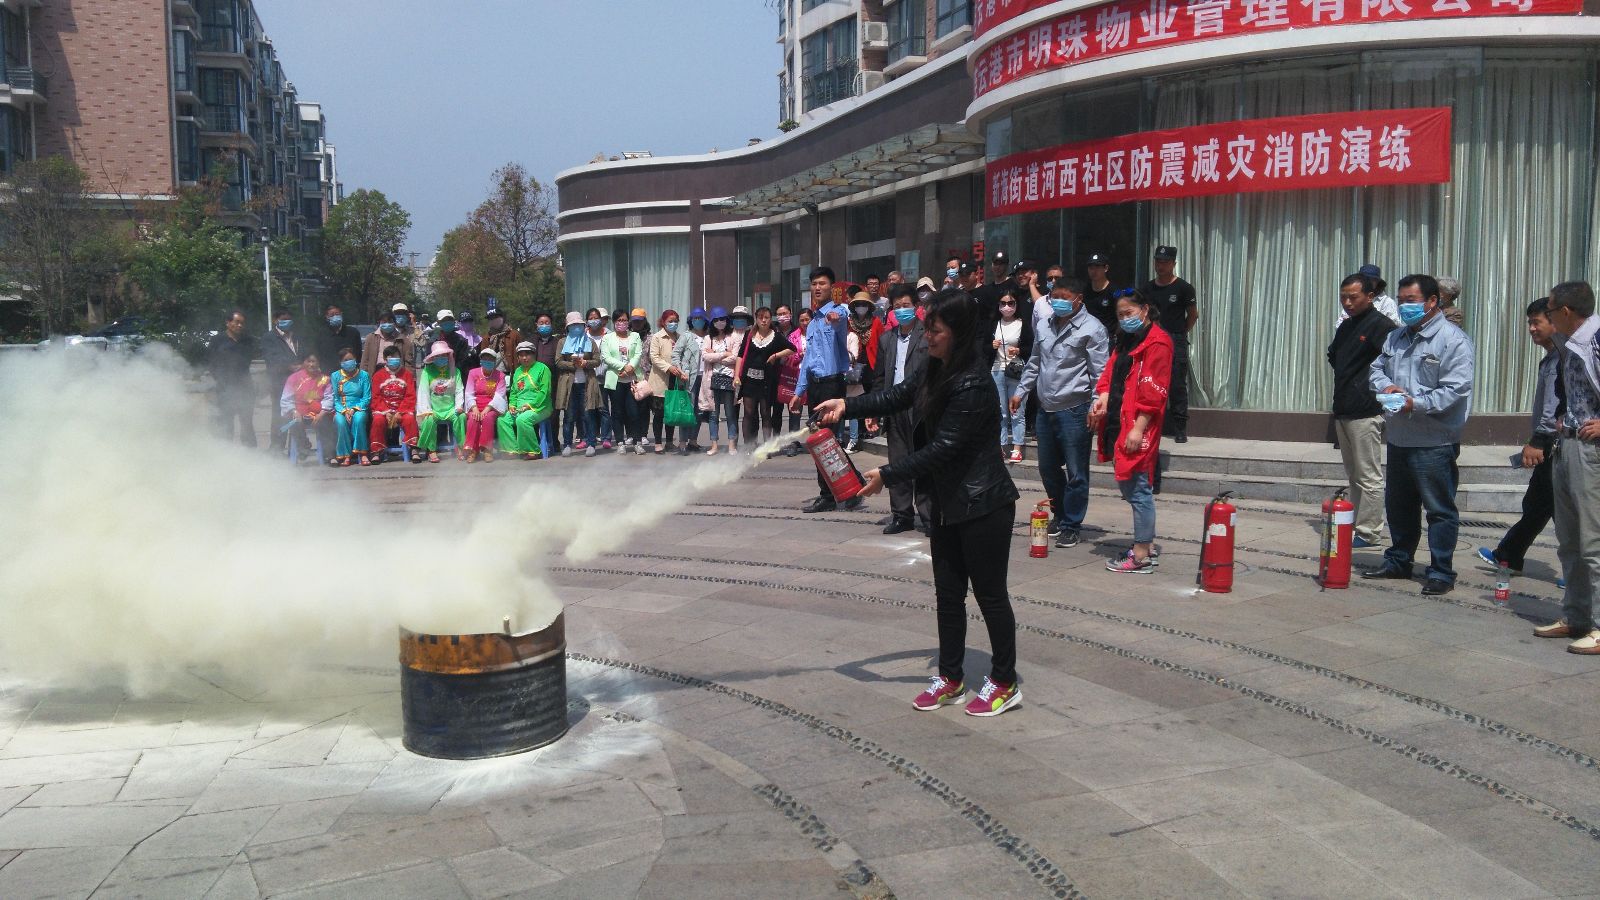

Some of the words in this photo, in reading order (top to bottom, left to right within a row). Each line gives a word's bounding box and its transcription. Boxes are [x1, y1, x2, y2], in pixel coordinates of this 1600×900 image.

[974, 0, 1533, 98] 云港市明珠物业管理
[992, 124, 1411, 208] 新海街道河西社区防震减灾消防演练
